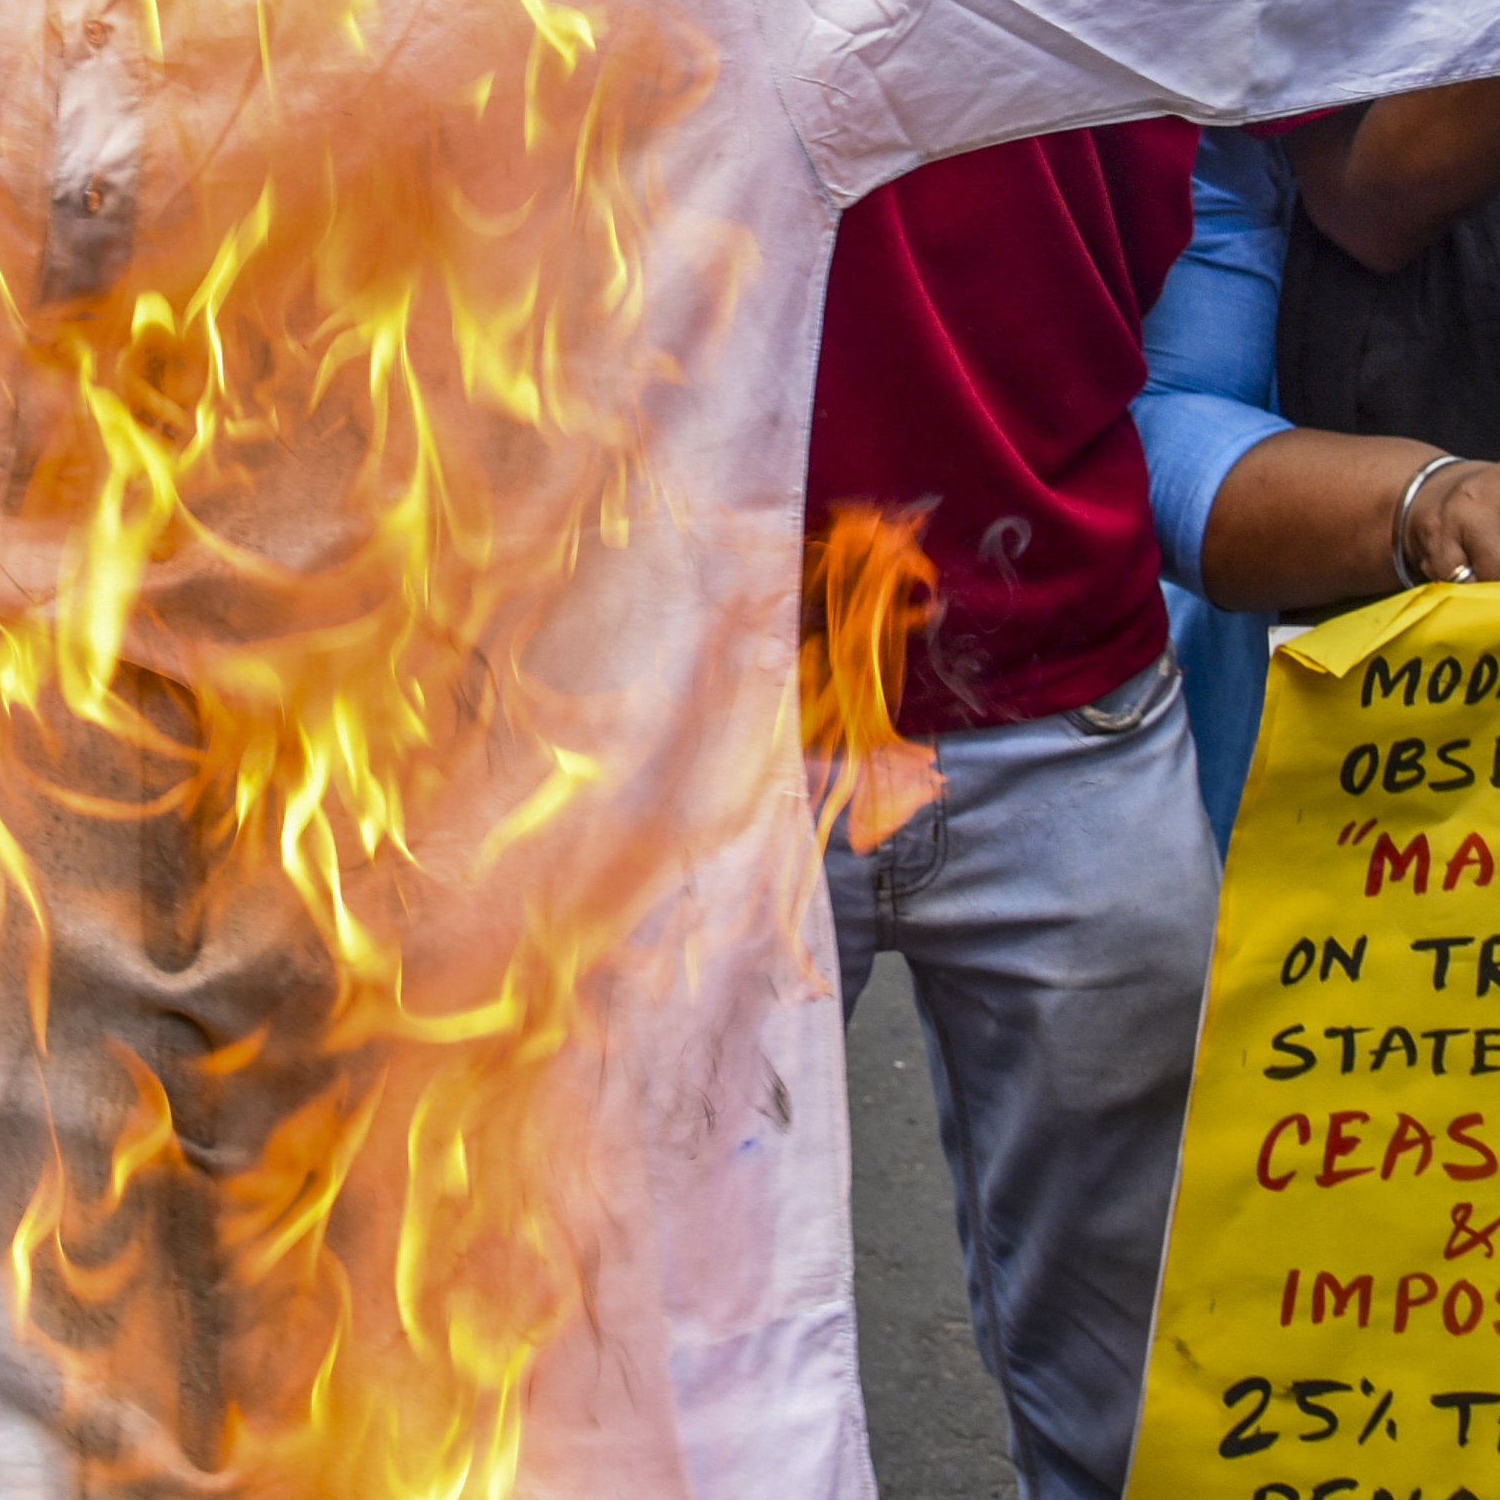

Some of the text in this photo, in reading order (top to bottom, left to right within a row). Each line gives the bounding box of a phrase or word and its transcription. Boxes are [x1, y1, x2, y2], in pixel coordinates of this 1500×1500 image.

[1361, 653, 1500, 708] MOD
[1281, 934, 1368, 987] ON
[1263, 1024, 1500, 1081] STATE
[1256, 1110, 1499, 1192] CEAS
[1443, 1202, 1500, 1260] &
[1280, 1269, 1500, 1336] IMPO
[1219, 1376, 1500, 1459] 25% T
